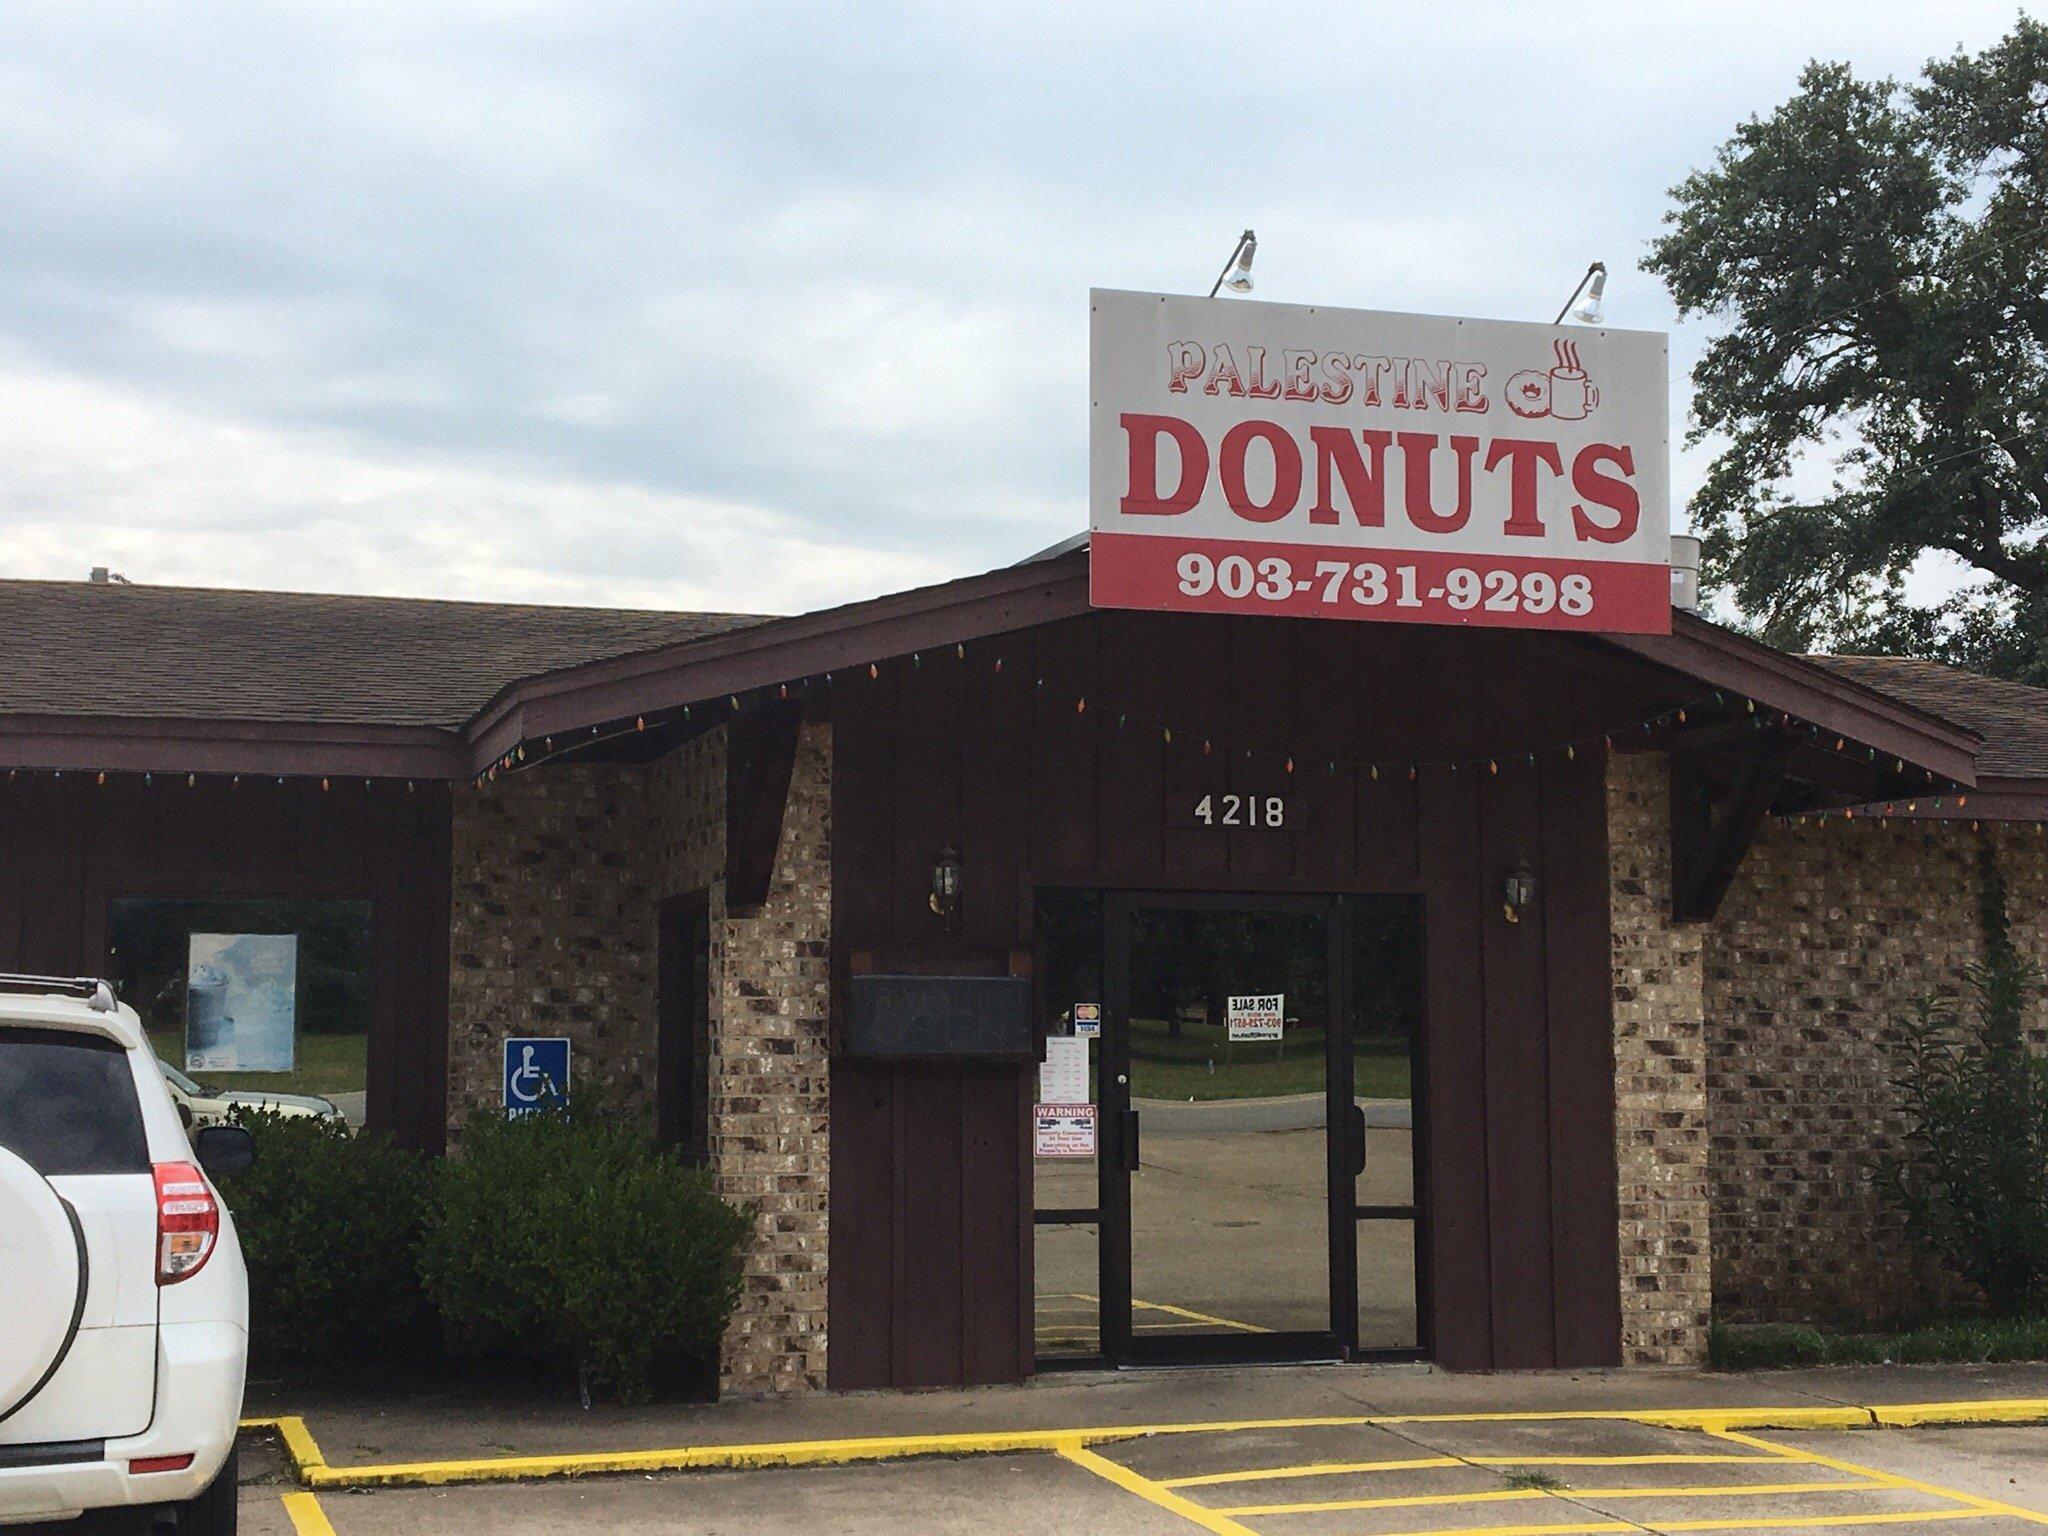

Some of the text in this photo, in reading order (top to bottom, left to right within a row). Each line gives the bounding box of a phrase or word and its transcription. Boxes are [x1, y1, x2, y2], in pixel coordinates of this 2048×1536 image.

[1167, 340, 1490, 414] PALESTINE
[1120, 412, 1641, 544] DONUTS
[1176, 553, 1594, 616] 903-731-9298
[1194, 794, 1284, 827] 4218
[1036, 1107, 1094, 1117] WARNING
